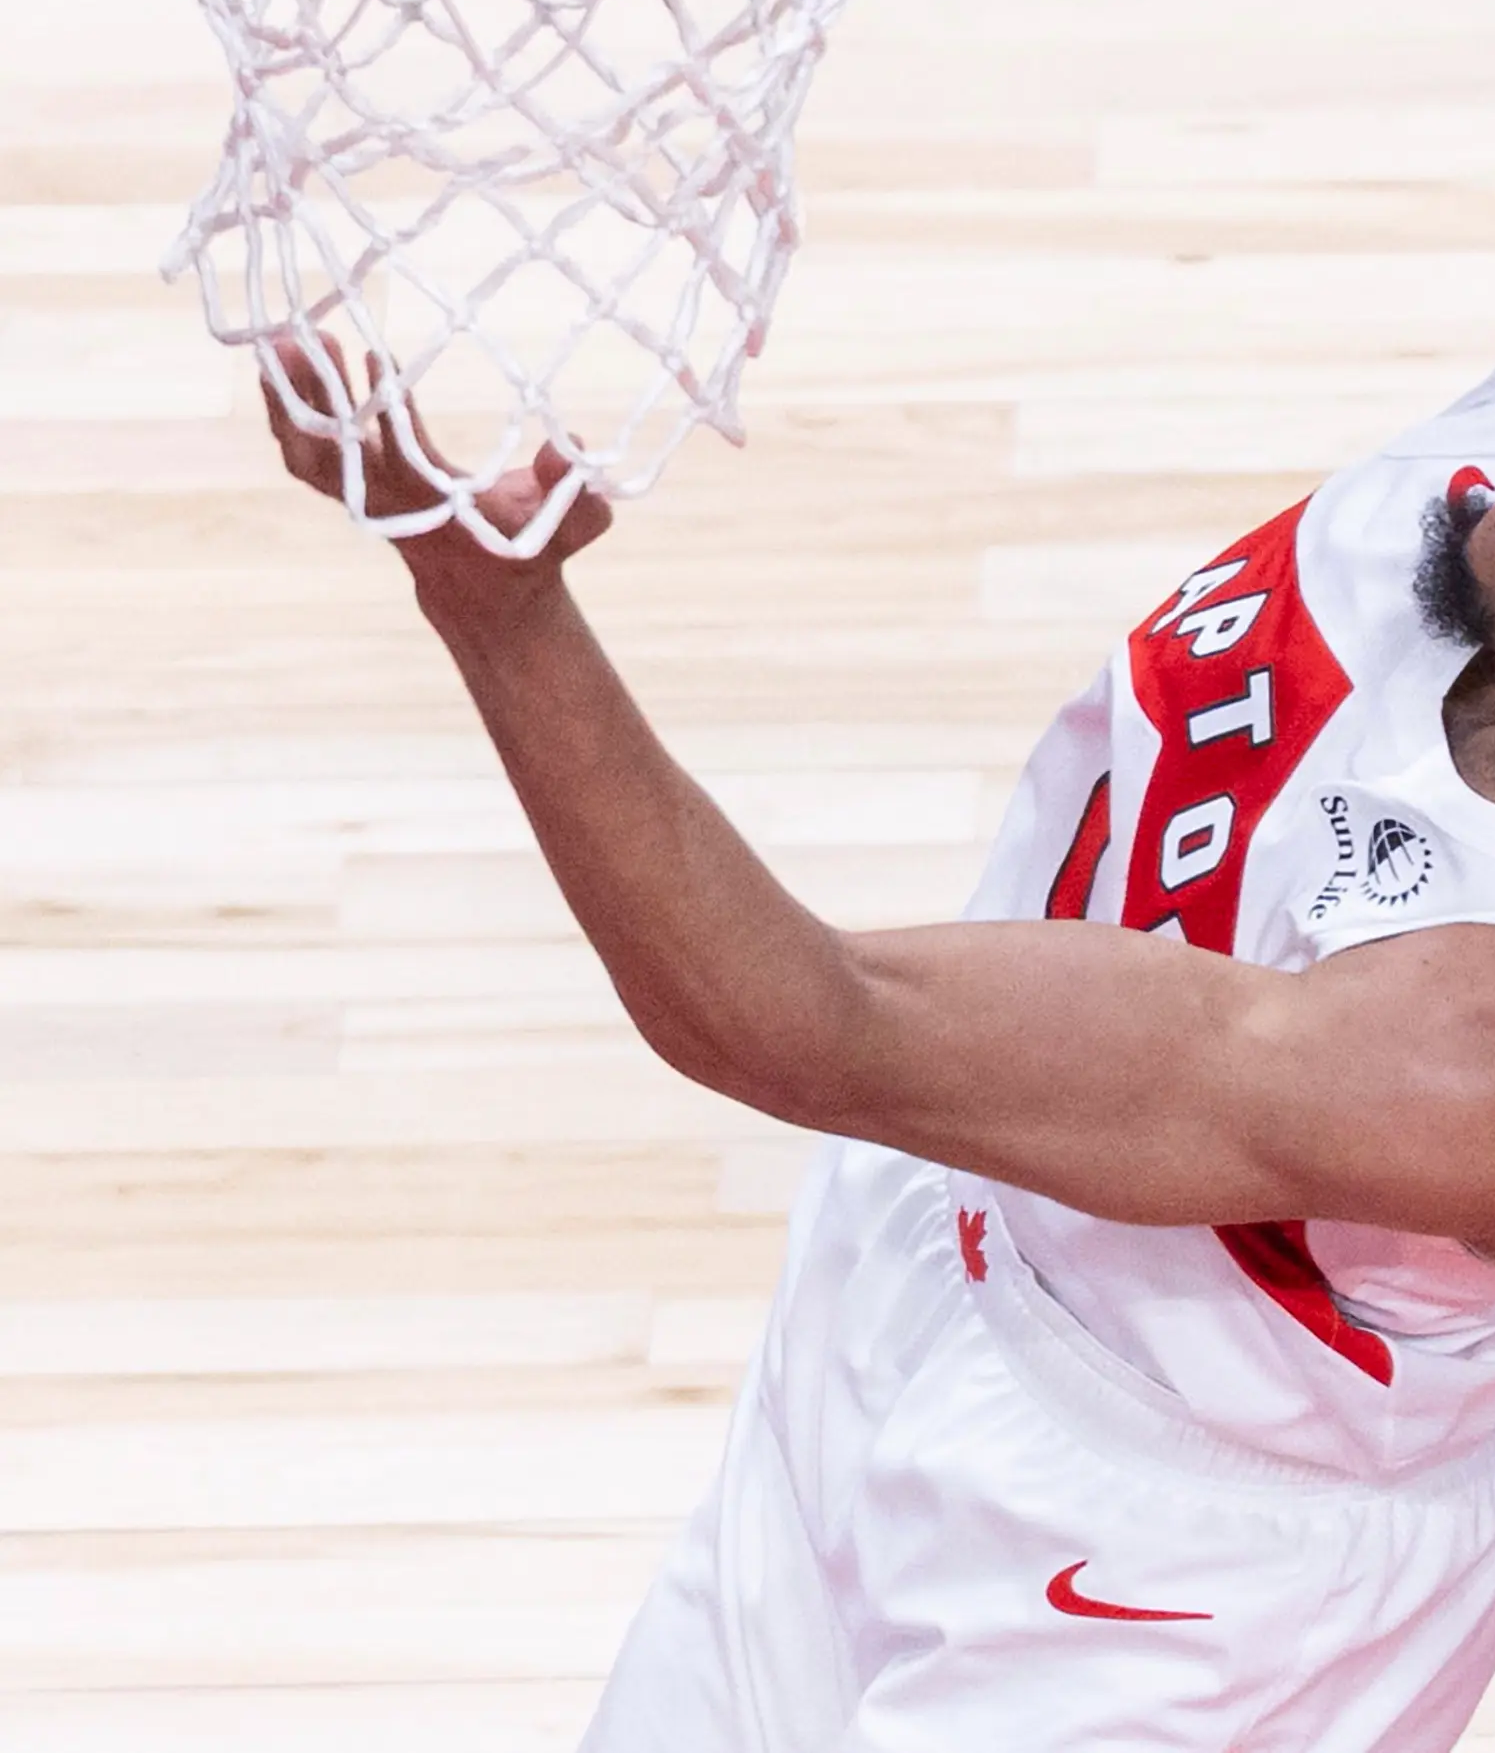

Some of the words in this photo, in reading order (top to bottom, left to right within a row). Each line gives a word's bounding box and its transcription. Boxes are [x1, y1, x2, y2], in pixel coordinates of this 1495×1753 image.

[1144, 556, 1276, 944] APTO
[1320, 796, 1354, 861] Sun
[1307, 869, 1357, 921] Life
